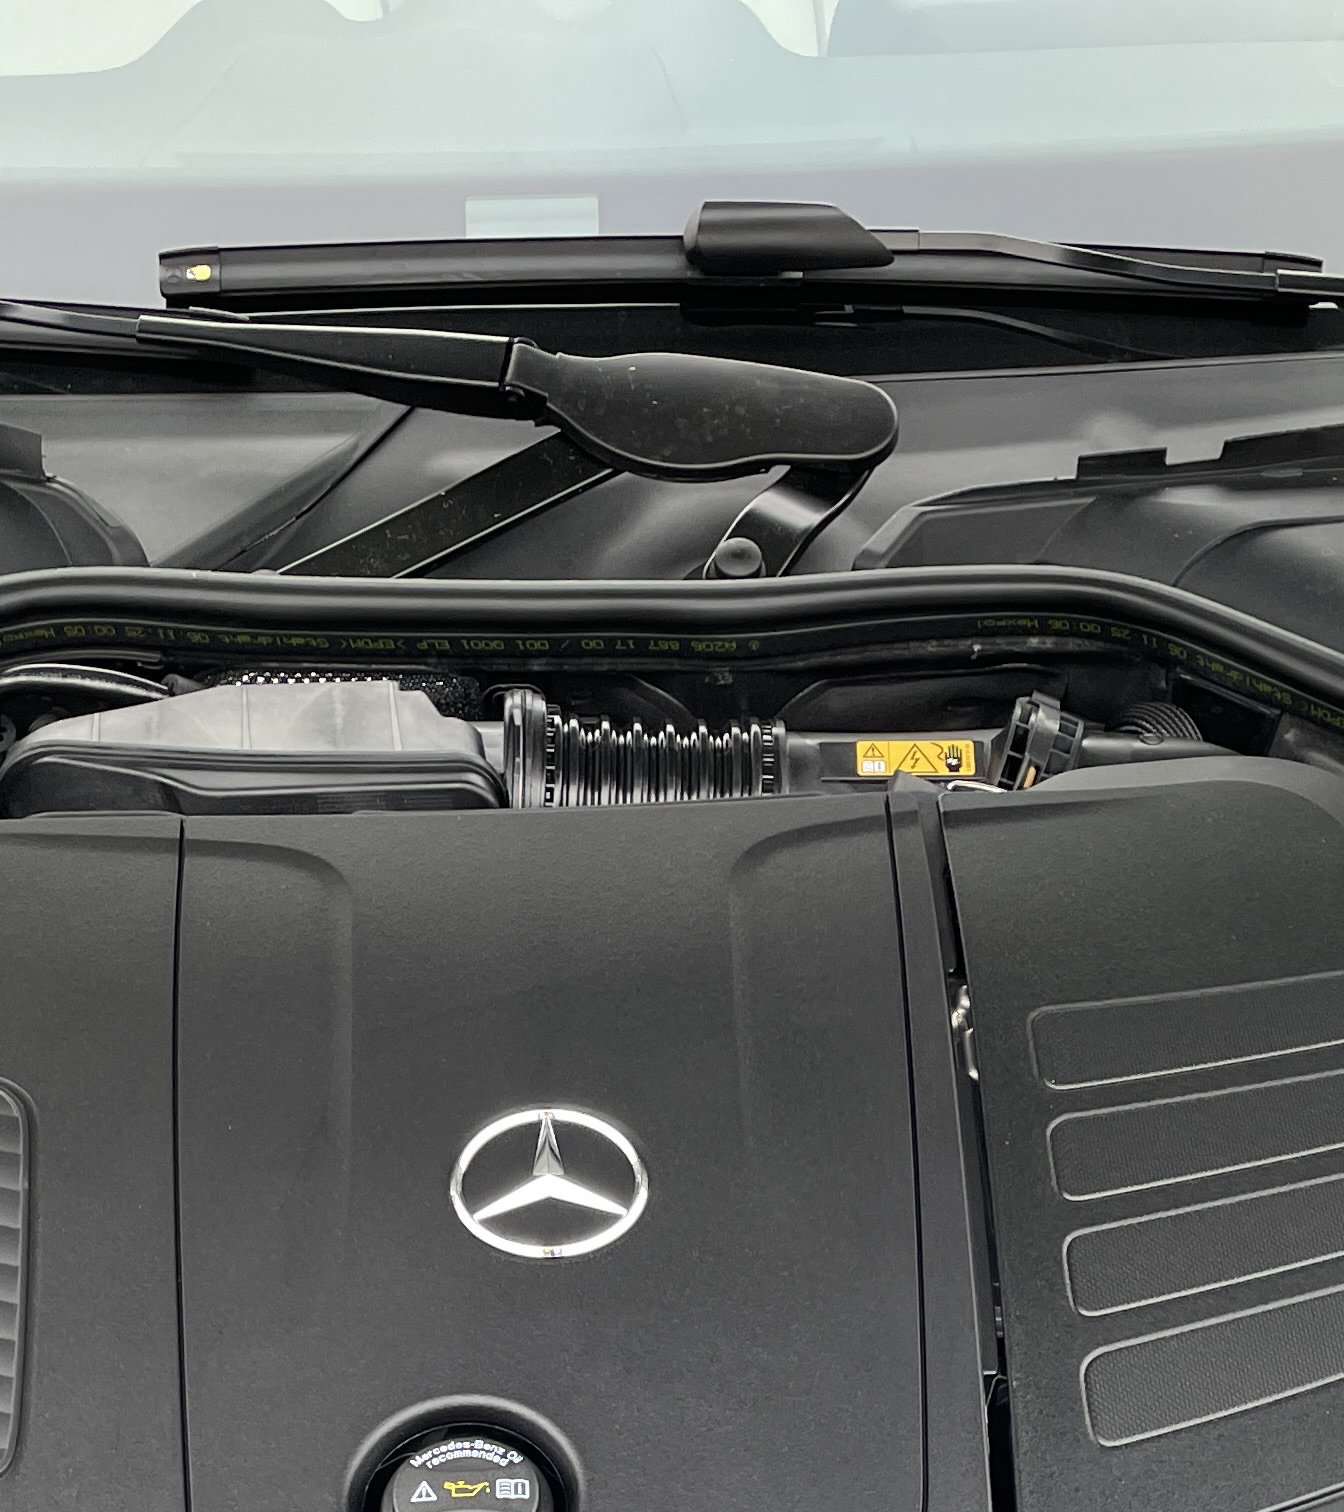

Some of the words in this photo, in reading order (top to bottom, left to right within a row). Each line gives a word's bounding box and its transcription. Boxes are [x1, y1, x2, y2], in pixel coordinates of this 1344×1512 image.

[417, 639, 451, 650] ELP
[614, 639, 636, 650] 17
[689, 639, 737, 652] A206
[409, 1439, 506, 1467] Mercedes-Benz
[506, 1450, 524, 1464] Oil
[425, 1449, 508, 1469] recommended
